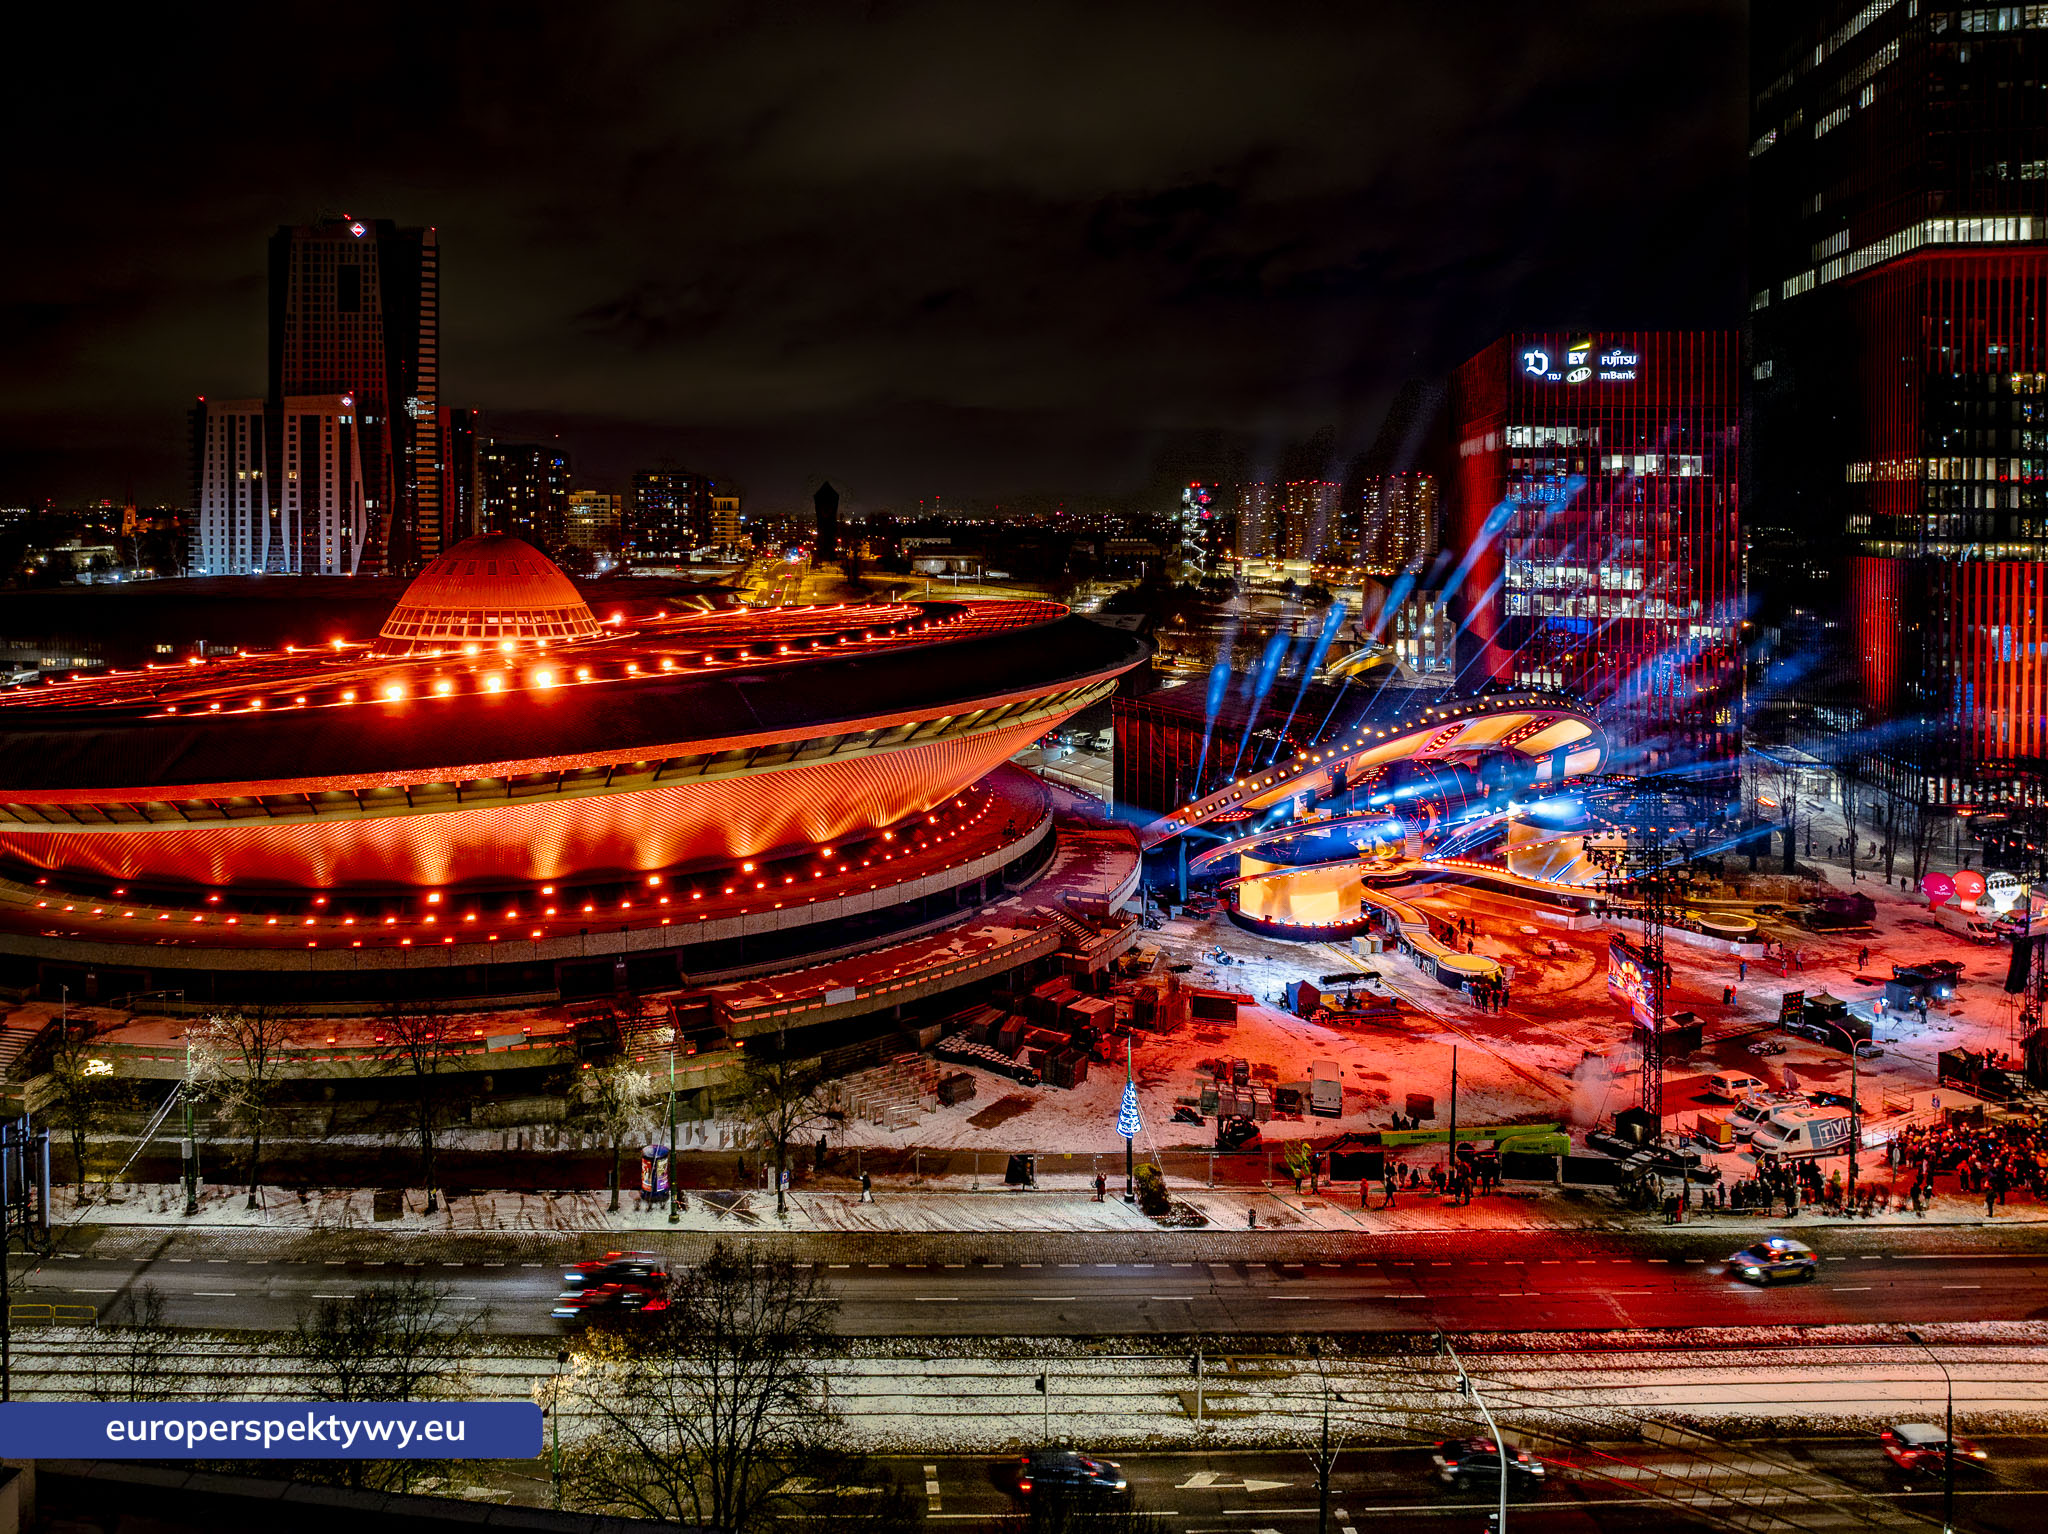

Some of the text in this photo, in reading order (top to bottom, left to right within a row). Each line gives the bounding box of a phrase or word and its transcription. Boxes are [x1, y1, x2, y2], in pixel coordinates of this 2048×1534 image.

[1568, 352, 1587, 365] EY
[1601, 355, 1637, 367] FUJITSU
[1547, 373, 1562, 381] TDJ
[1600, 370, 1636, 380] mBank
